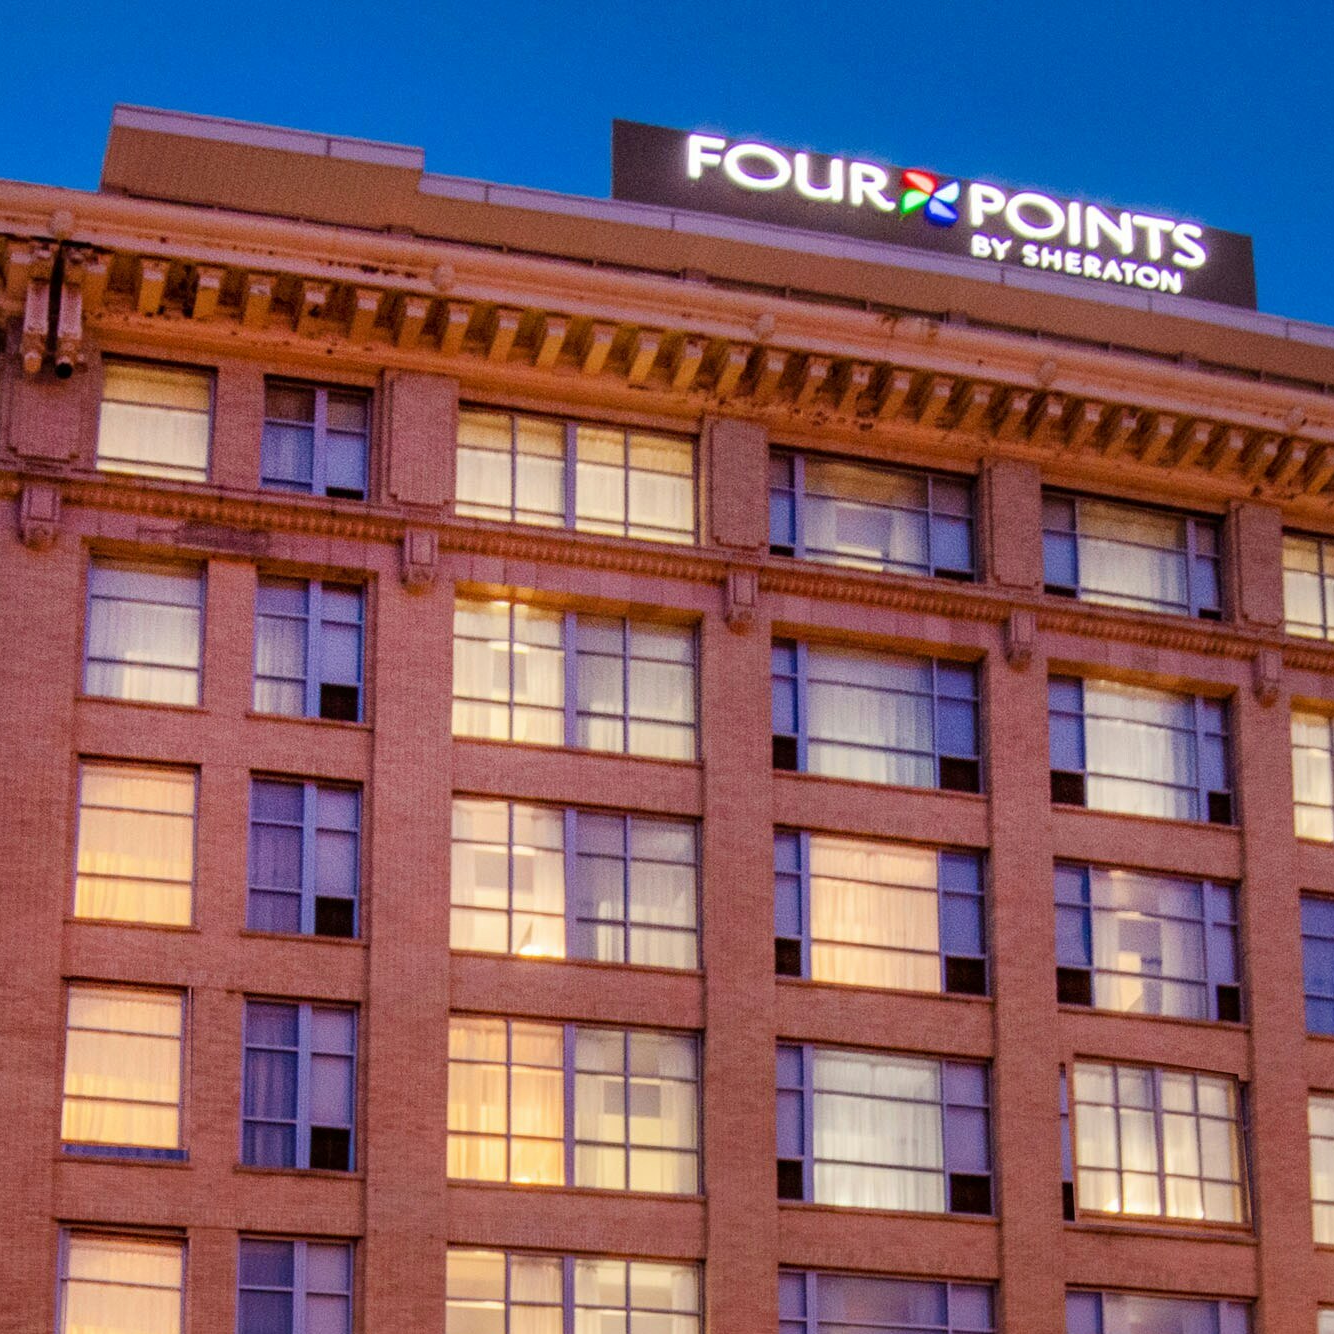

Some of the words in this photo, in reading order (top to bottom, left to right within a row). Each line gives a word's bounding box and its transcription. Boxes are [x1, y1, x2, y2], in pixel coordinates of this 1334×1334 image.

[687, 131, 897, 212] FOUR
[969, 181, 1208, 270] POINTS
[970, 232, 1012, 262] BY
[1021, 243, 1184, 296] SHERATON
